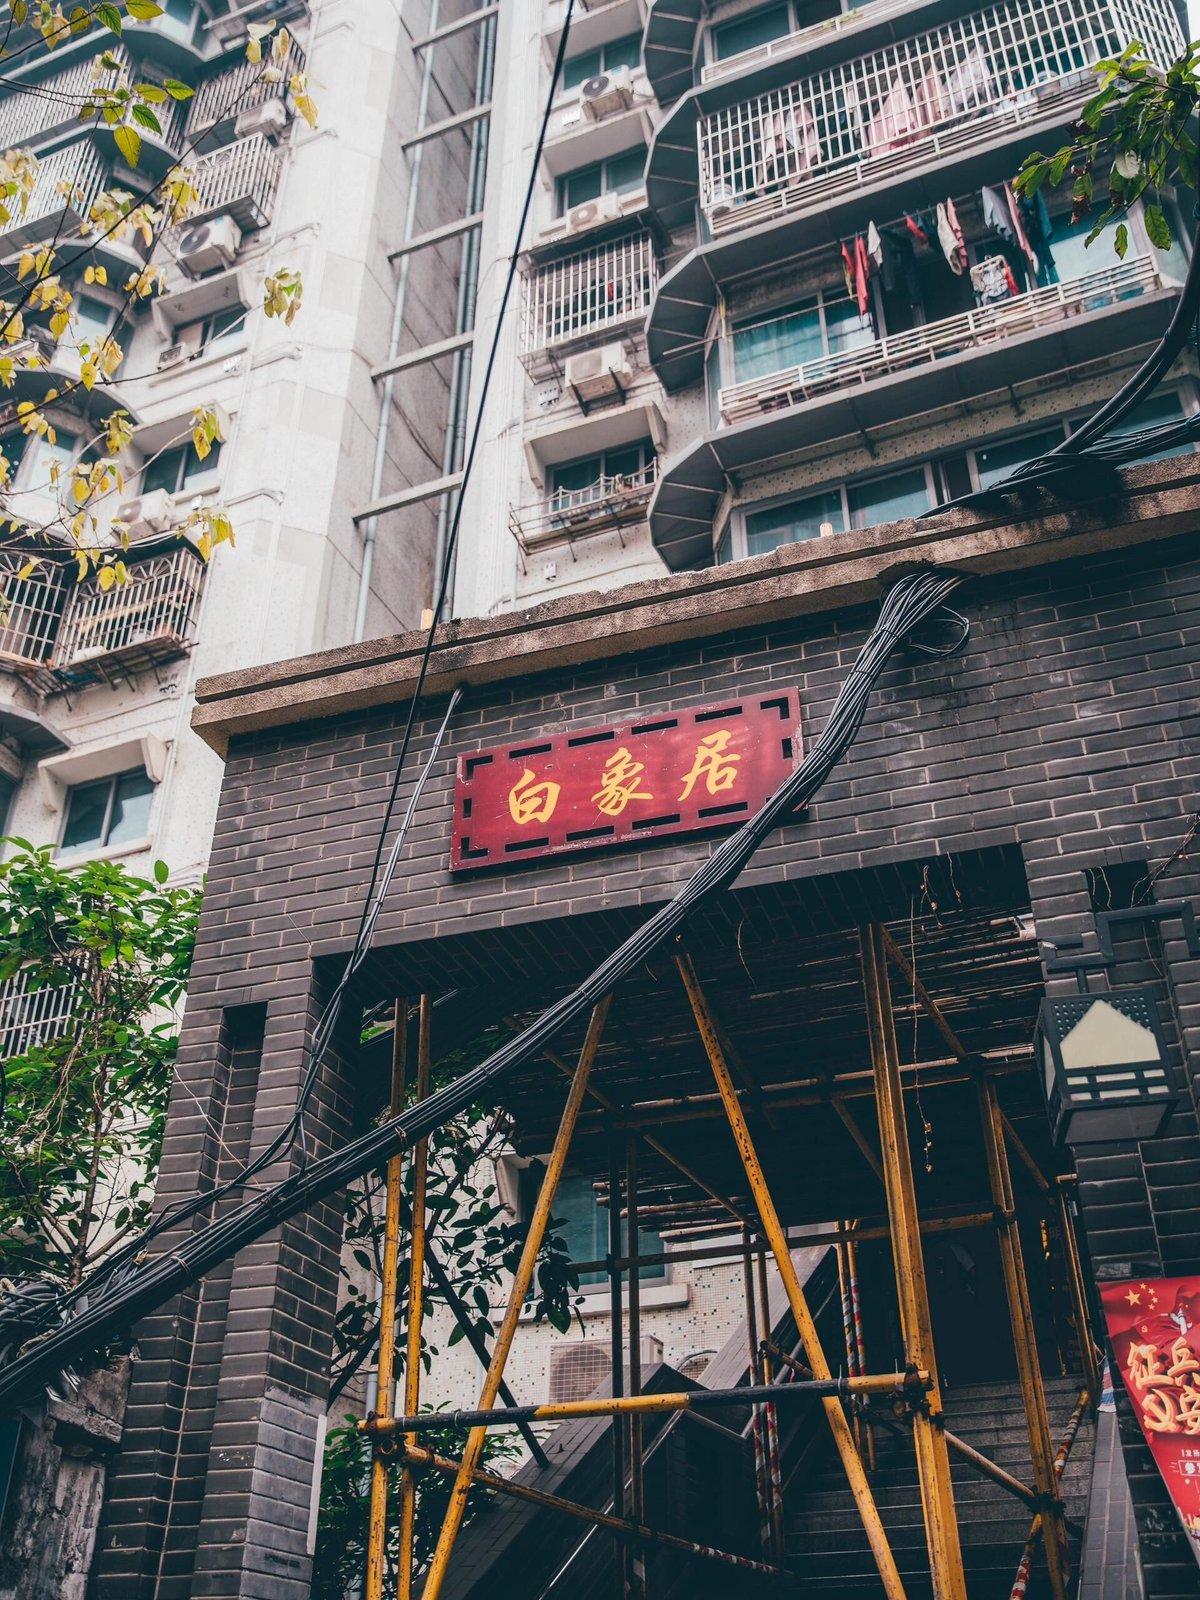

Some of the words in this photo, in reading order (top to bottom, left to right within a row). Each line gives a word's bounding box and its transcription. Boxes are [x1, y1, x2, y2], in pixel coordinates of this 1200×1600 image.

[508, 729, 741, 825] 白象居
[1127, 1336, 1200, 1390] 征兵
